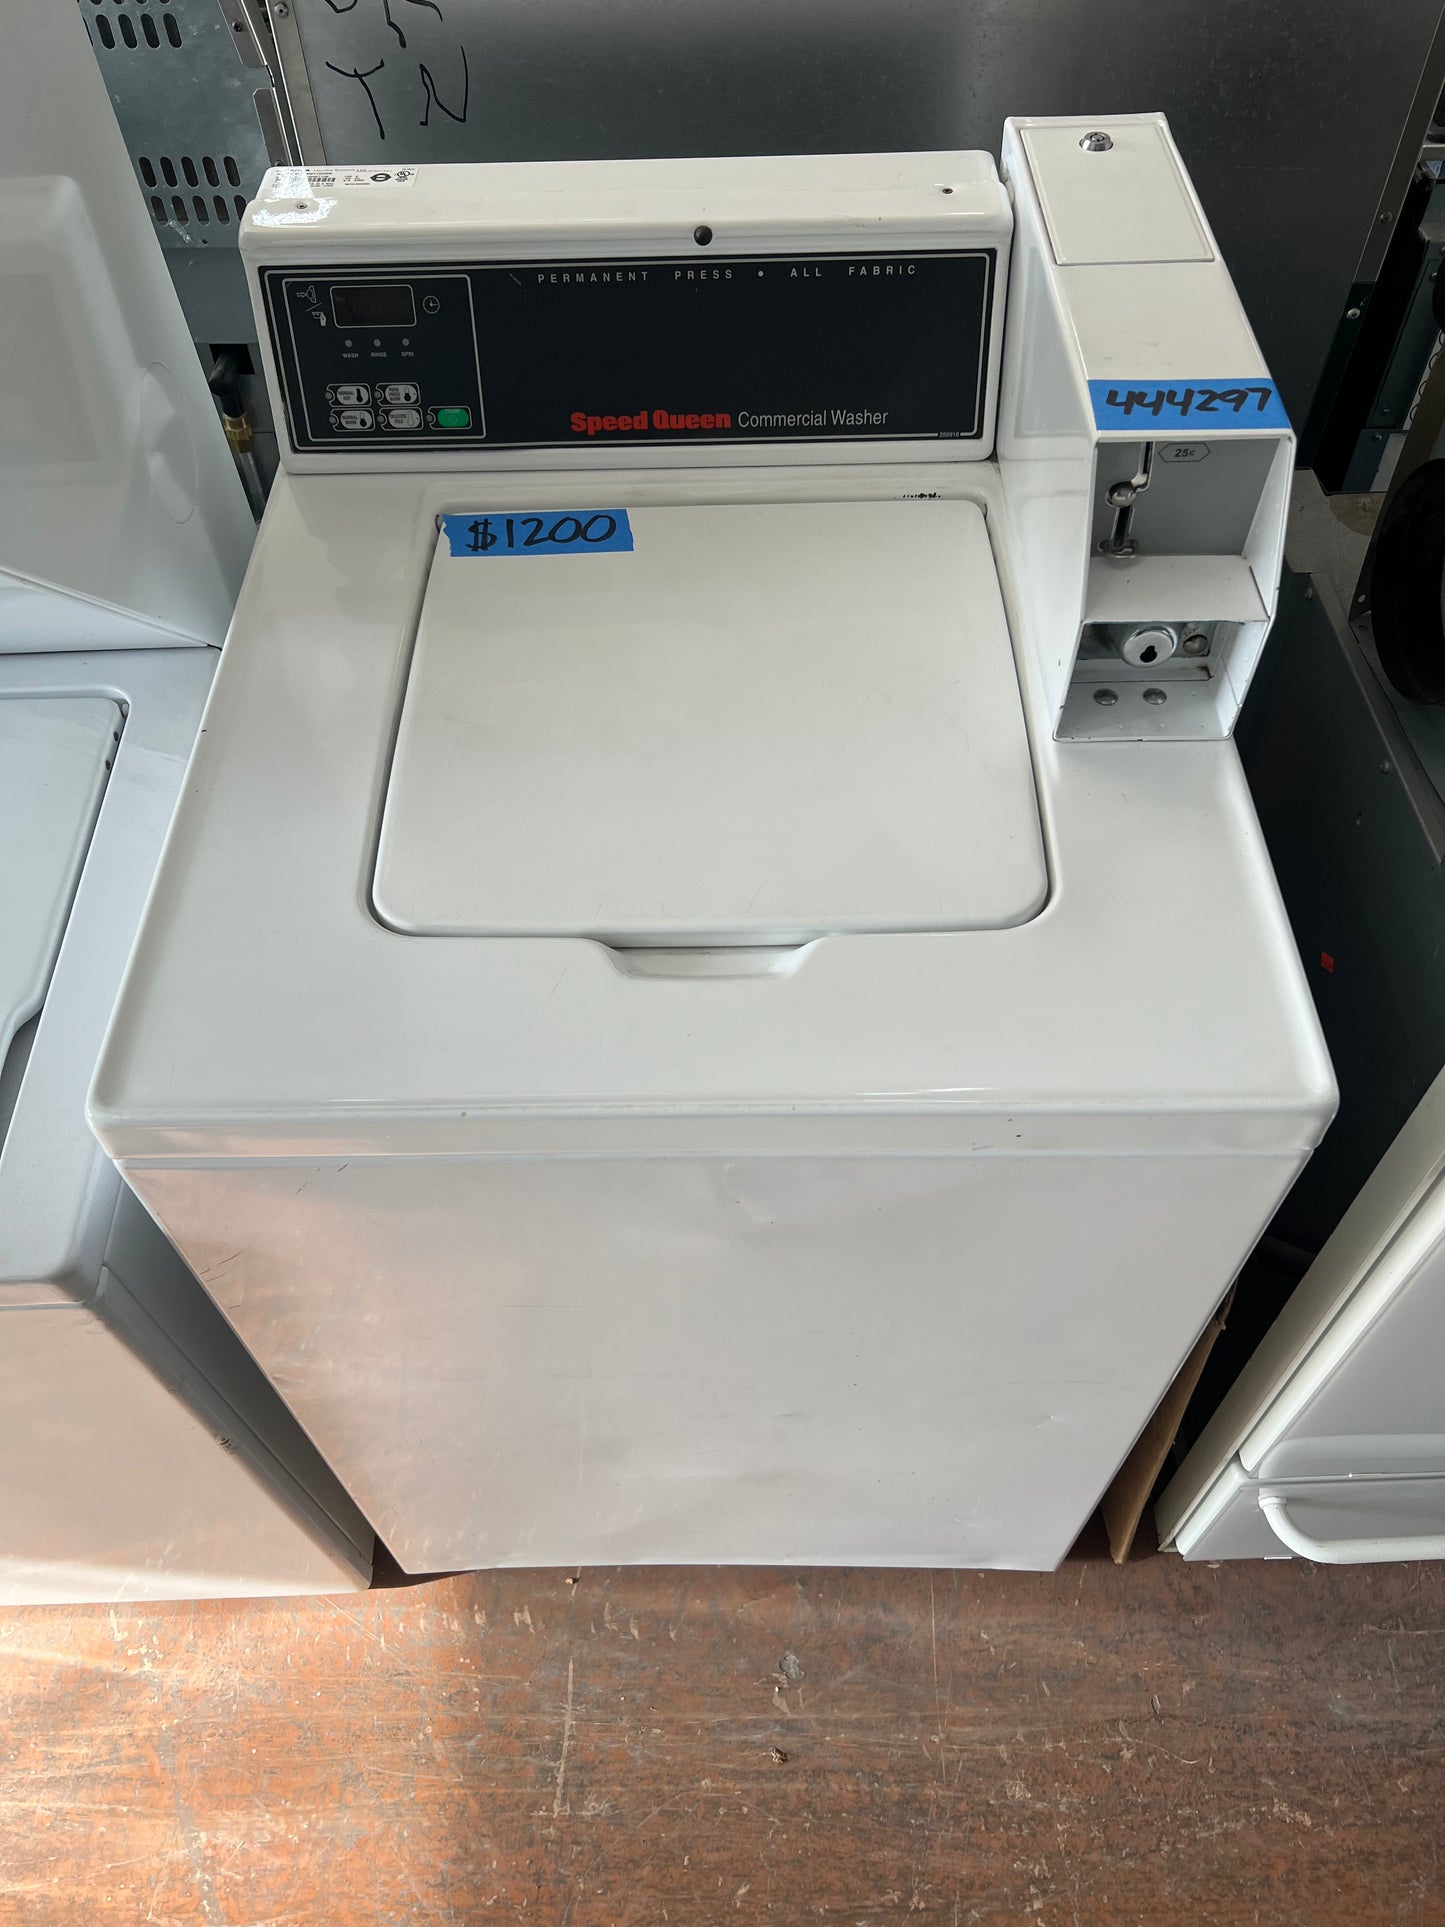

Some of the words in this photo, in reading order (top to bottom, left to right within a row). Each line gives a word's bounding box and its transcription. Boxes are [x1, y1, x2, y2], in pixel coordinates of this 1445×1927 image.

[538, 271, 648, 283] PERMANENT
[674, 269, 733, 281] PRESS
[790, 267, 822, 278] ALL
[849, 265, 916, 276] FABRIC
[1106, 388, 1272, 416] 444297
[570, 410, 648, 436] Speed
[652, 409, 731, 430] Queen
[738, 410, 827, 428] Commercial
[831, 409, 889, 426] Washer
[465, 514, 617, 552] $1200
